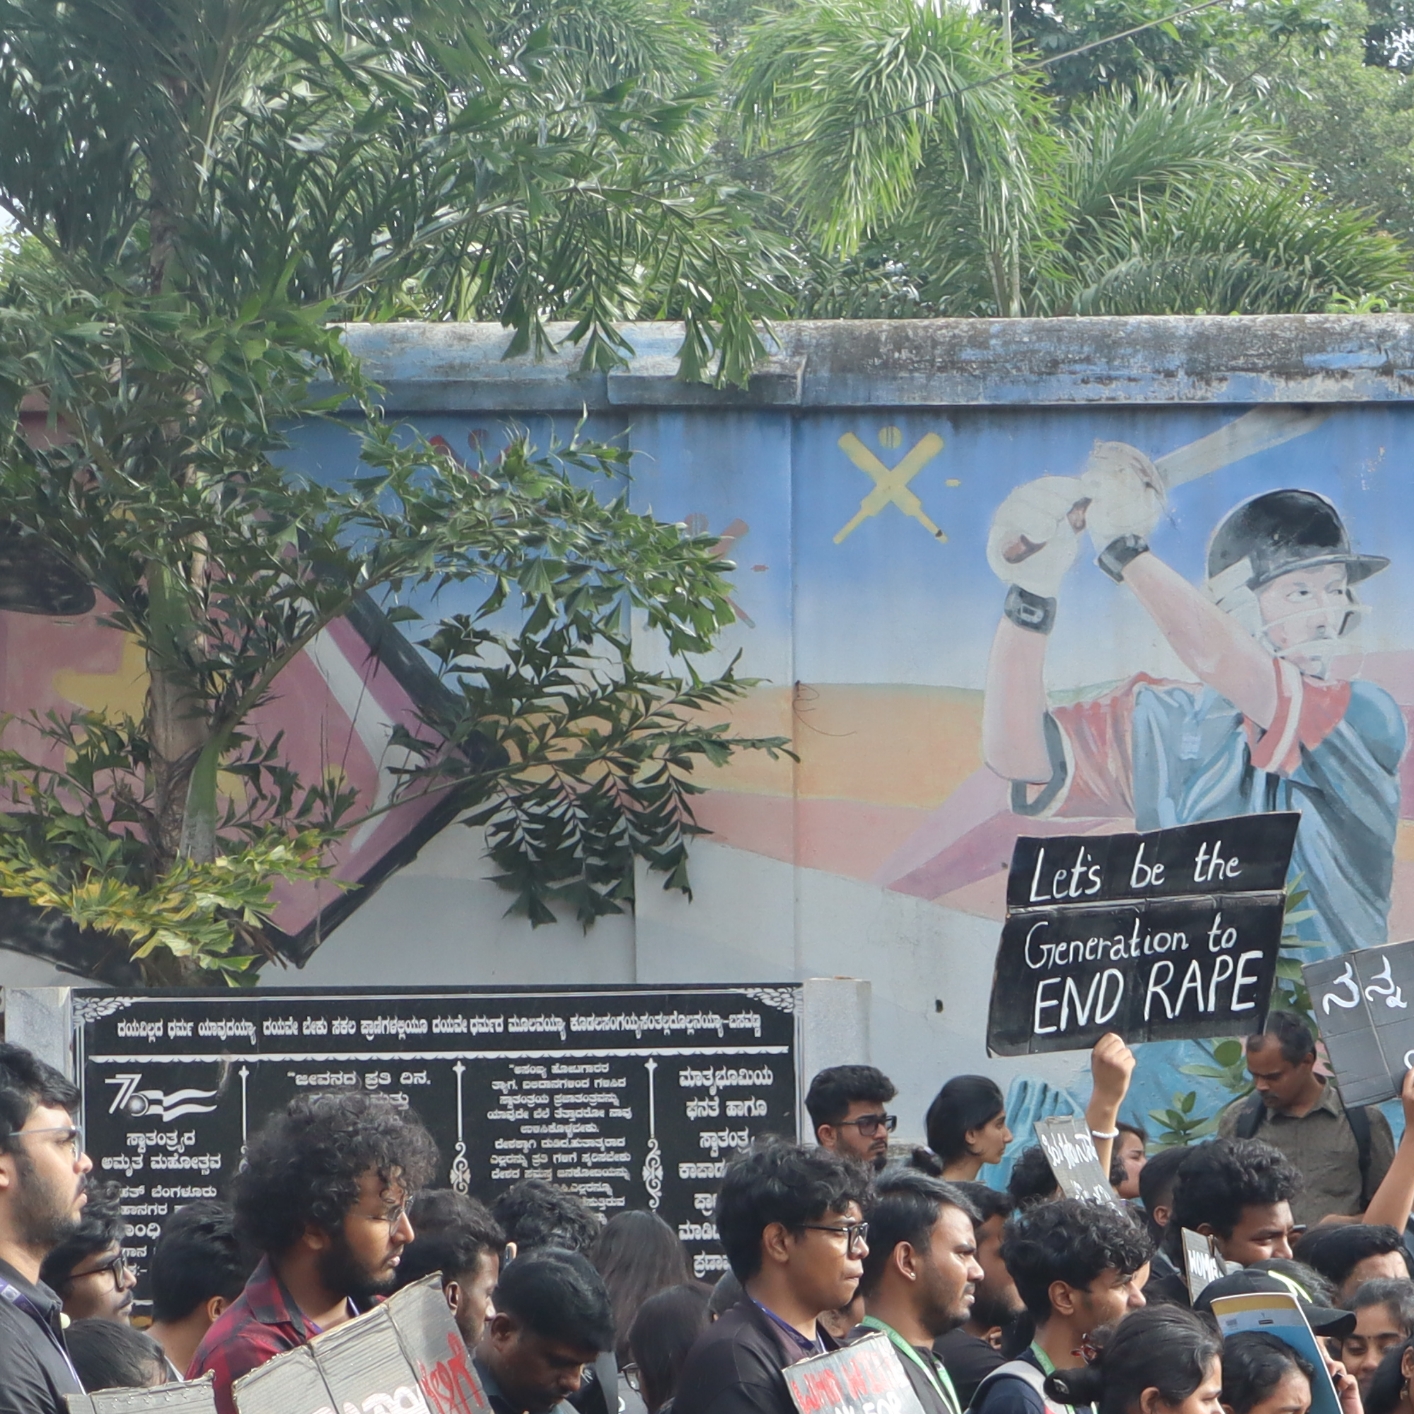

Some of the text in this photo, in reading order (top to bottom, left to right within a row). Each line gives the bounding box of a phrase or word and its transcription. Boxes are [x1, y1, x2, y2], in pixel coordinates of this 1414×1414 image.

[1030, 840, 1242, 902] Let's be the
[1024, 912, 1238, 970] Generation to
[1034, 950, 1264, 1035] END RAPE
